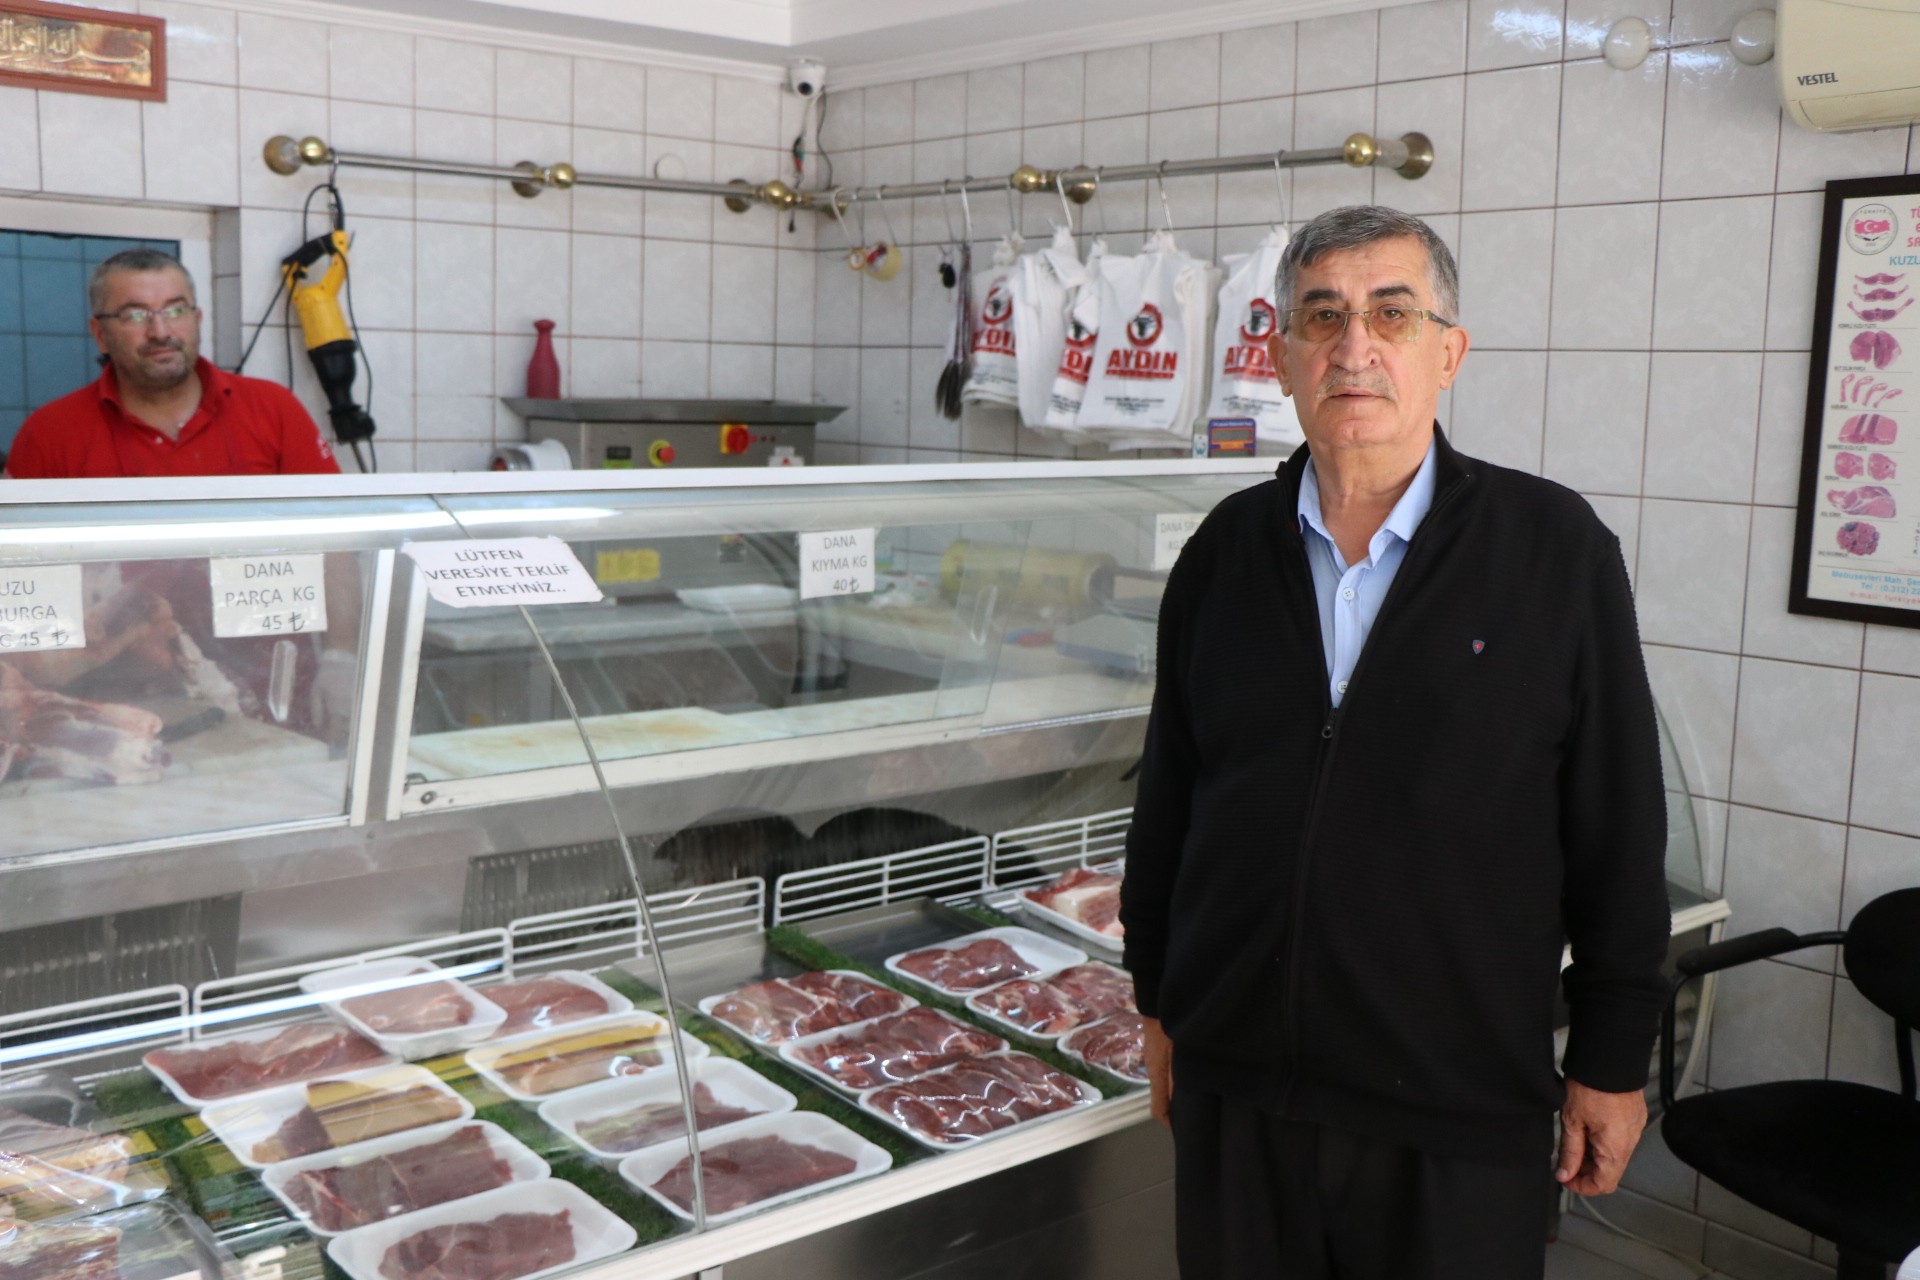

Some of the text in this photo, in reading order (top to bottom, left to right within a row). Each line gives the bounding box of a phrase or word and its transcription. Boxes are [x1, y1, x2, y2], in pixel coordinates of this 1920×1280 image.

[1797, 72, 1839, 86] VESTEL
[1107, 349, 1178, 371] AYDIN
[823, 535, 856, 550] DANA
[455, 549, 524, 562] LÜTFEN
[811, 555, 868, 572] KIYMA KG
[244, 561, 294, 578] DANA
[426, 564, 571, 580] VERESİYE TEKLİF
[225, 585, 315, 608] PARÇA KG
